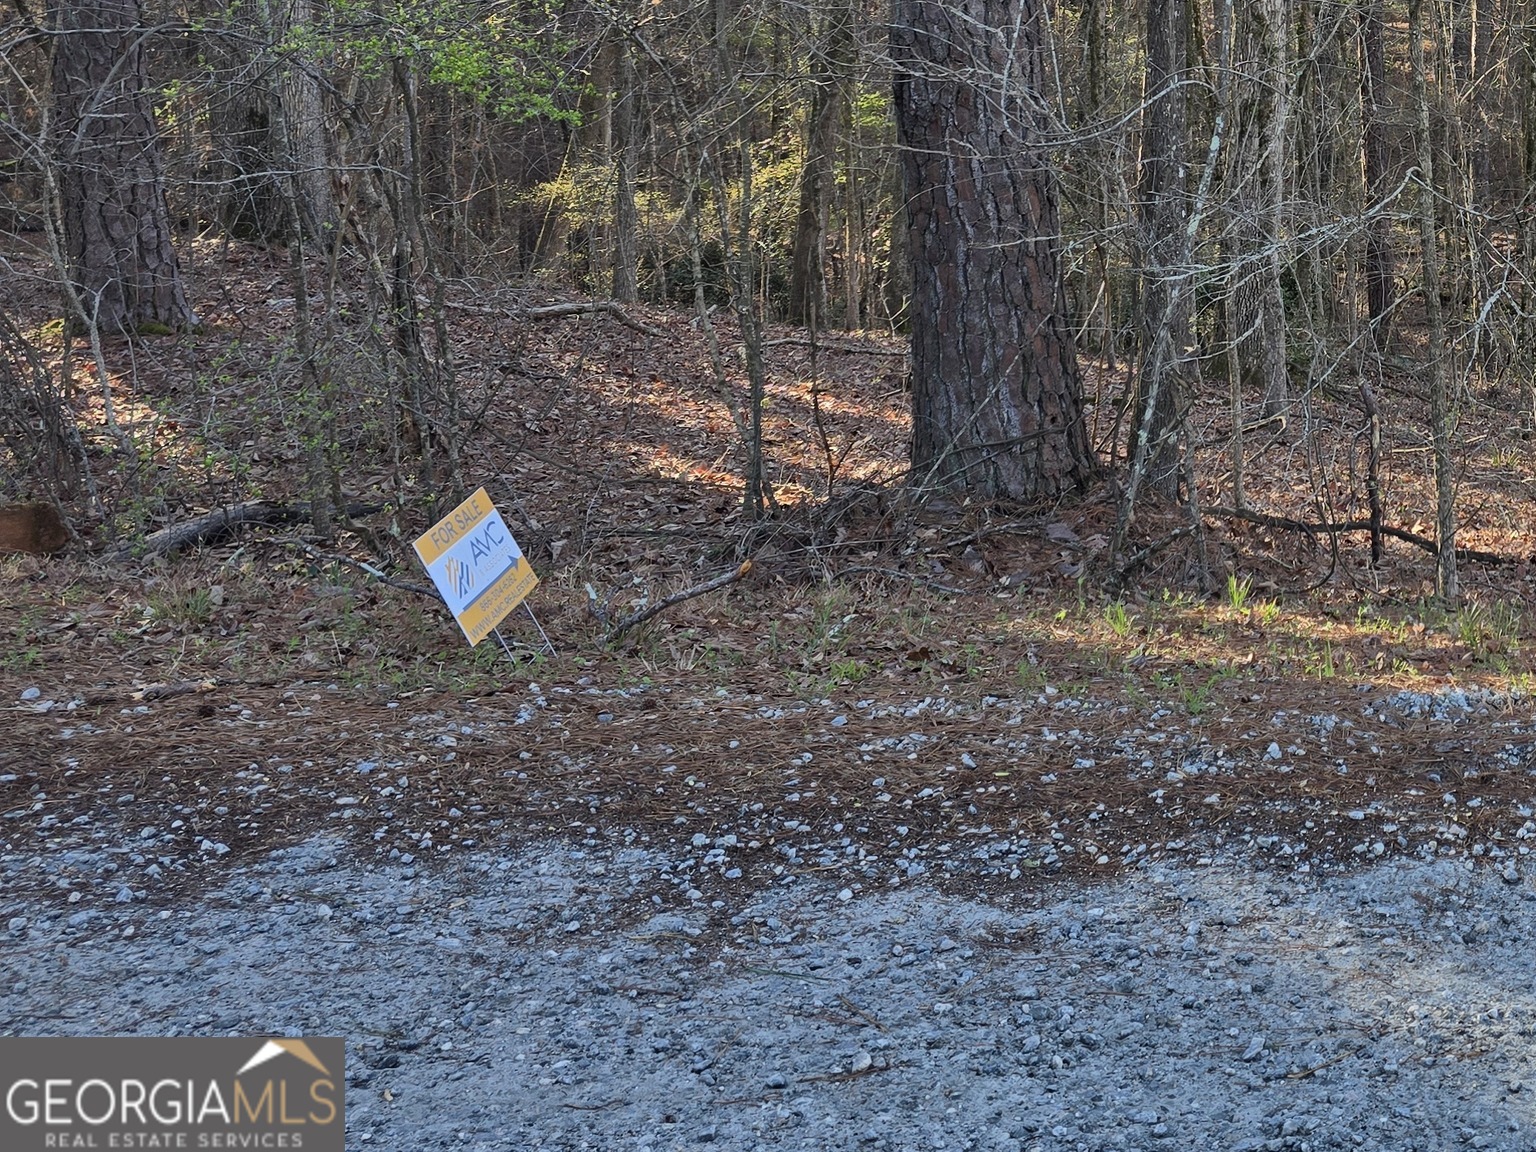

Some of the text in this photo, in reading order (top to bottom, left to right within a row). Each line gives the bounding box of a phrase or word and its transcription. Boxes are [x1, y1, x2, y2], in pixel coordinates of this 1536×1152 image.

[430, 499, 484, 550] FOR SALE
[469, 520, 504, 567] AMC
